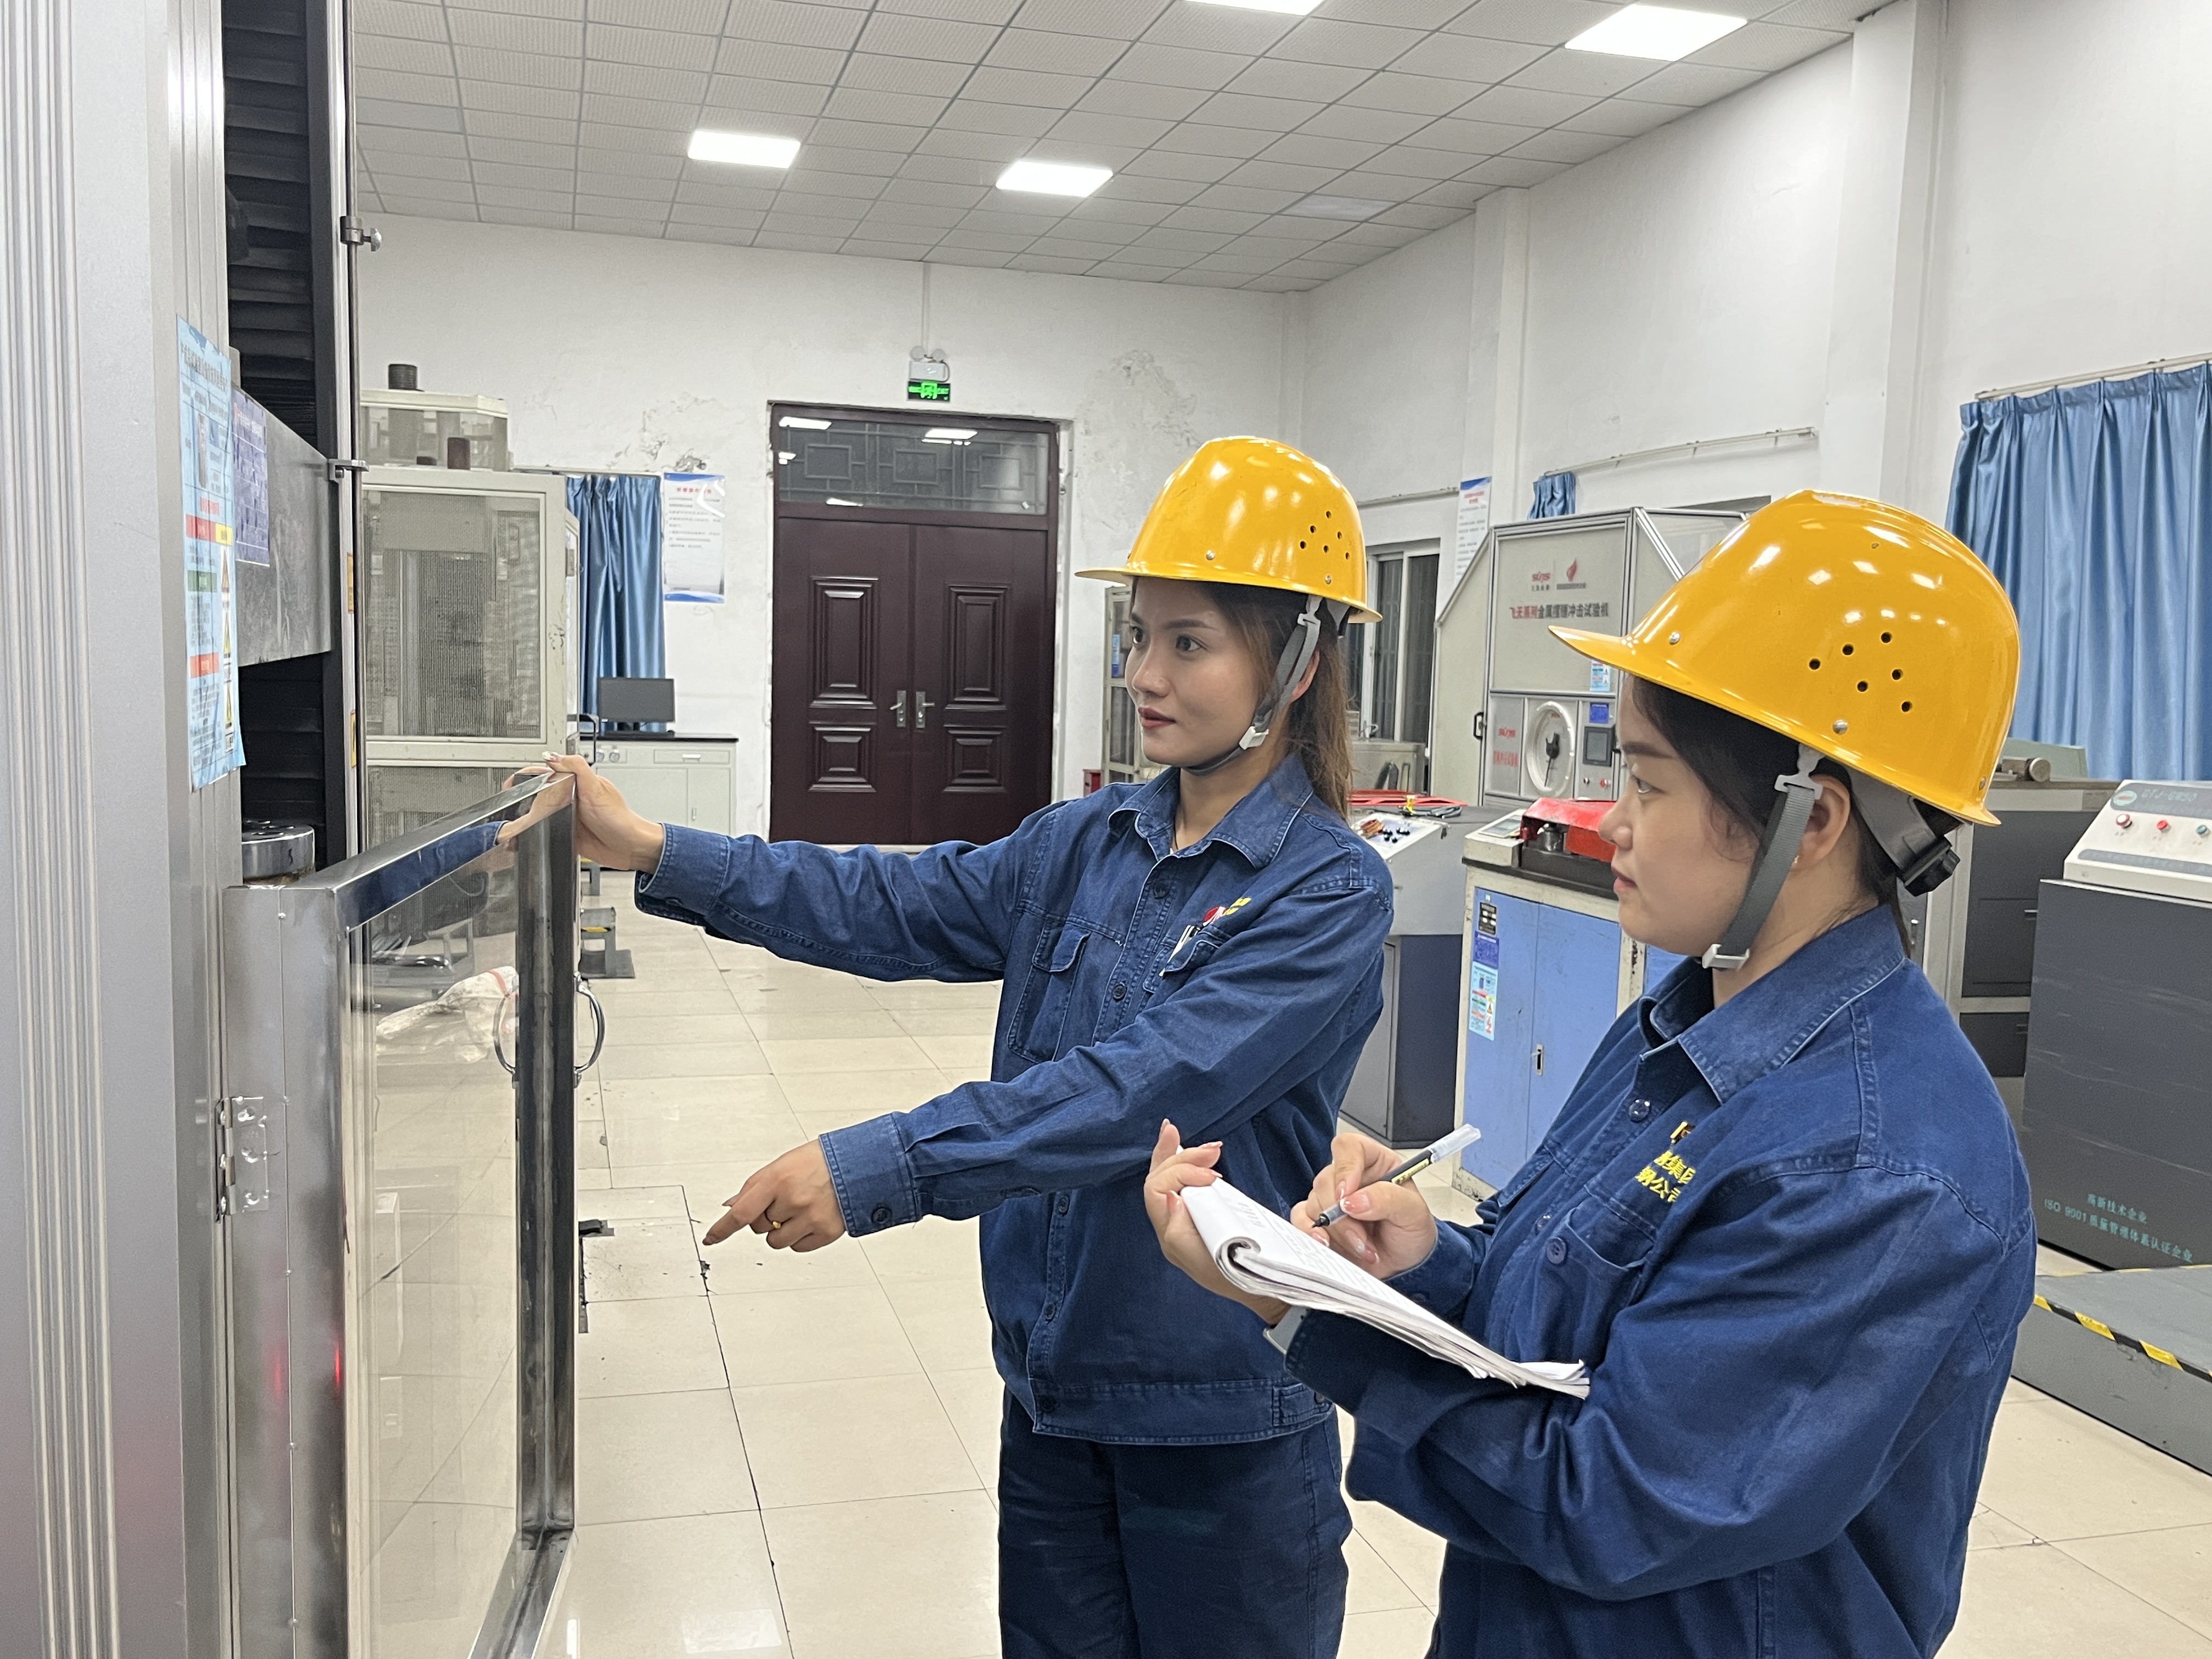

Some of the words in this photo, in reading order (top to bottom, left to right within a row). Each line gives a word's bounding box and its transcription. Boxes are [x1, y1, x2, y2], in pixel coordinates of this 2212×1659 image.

[2045, 1199, 2061, 1212] ISO
[2087, 1194, 2147, 1223] 高新技术企业
